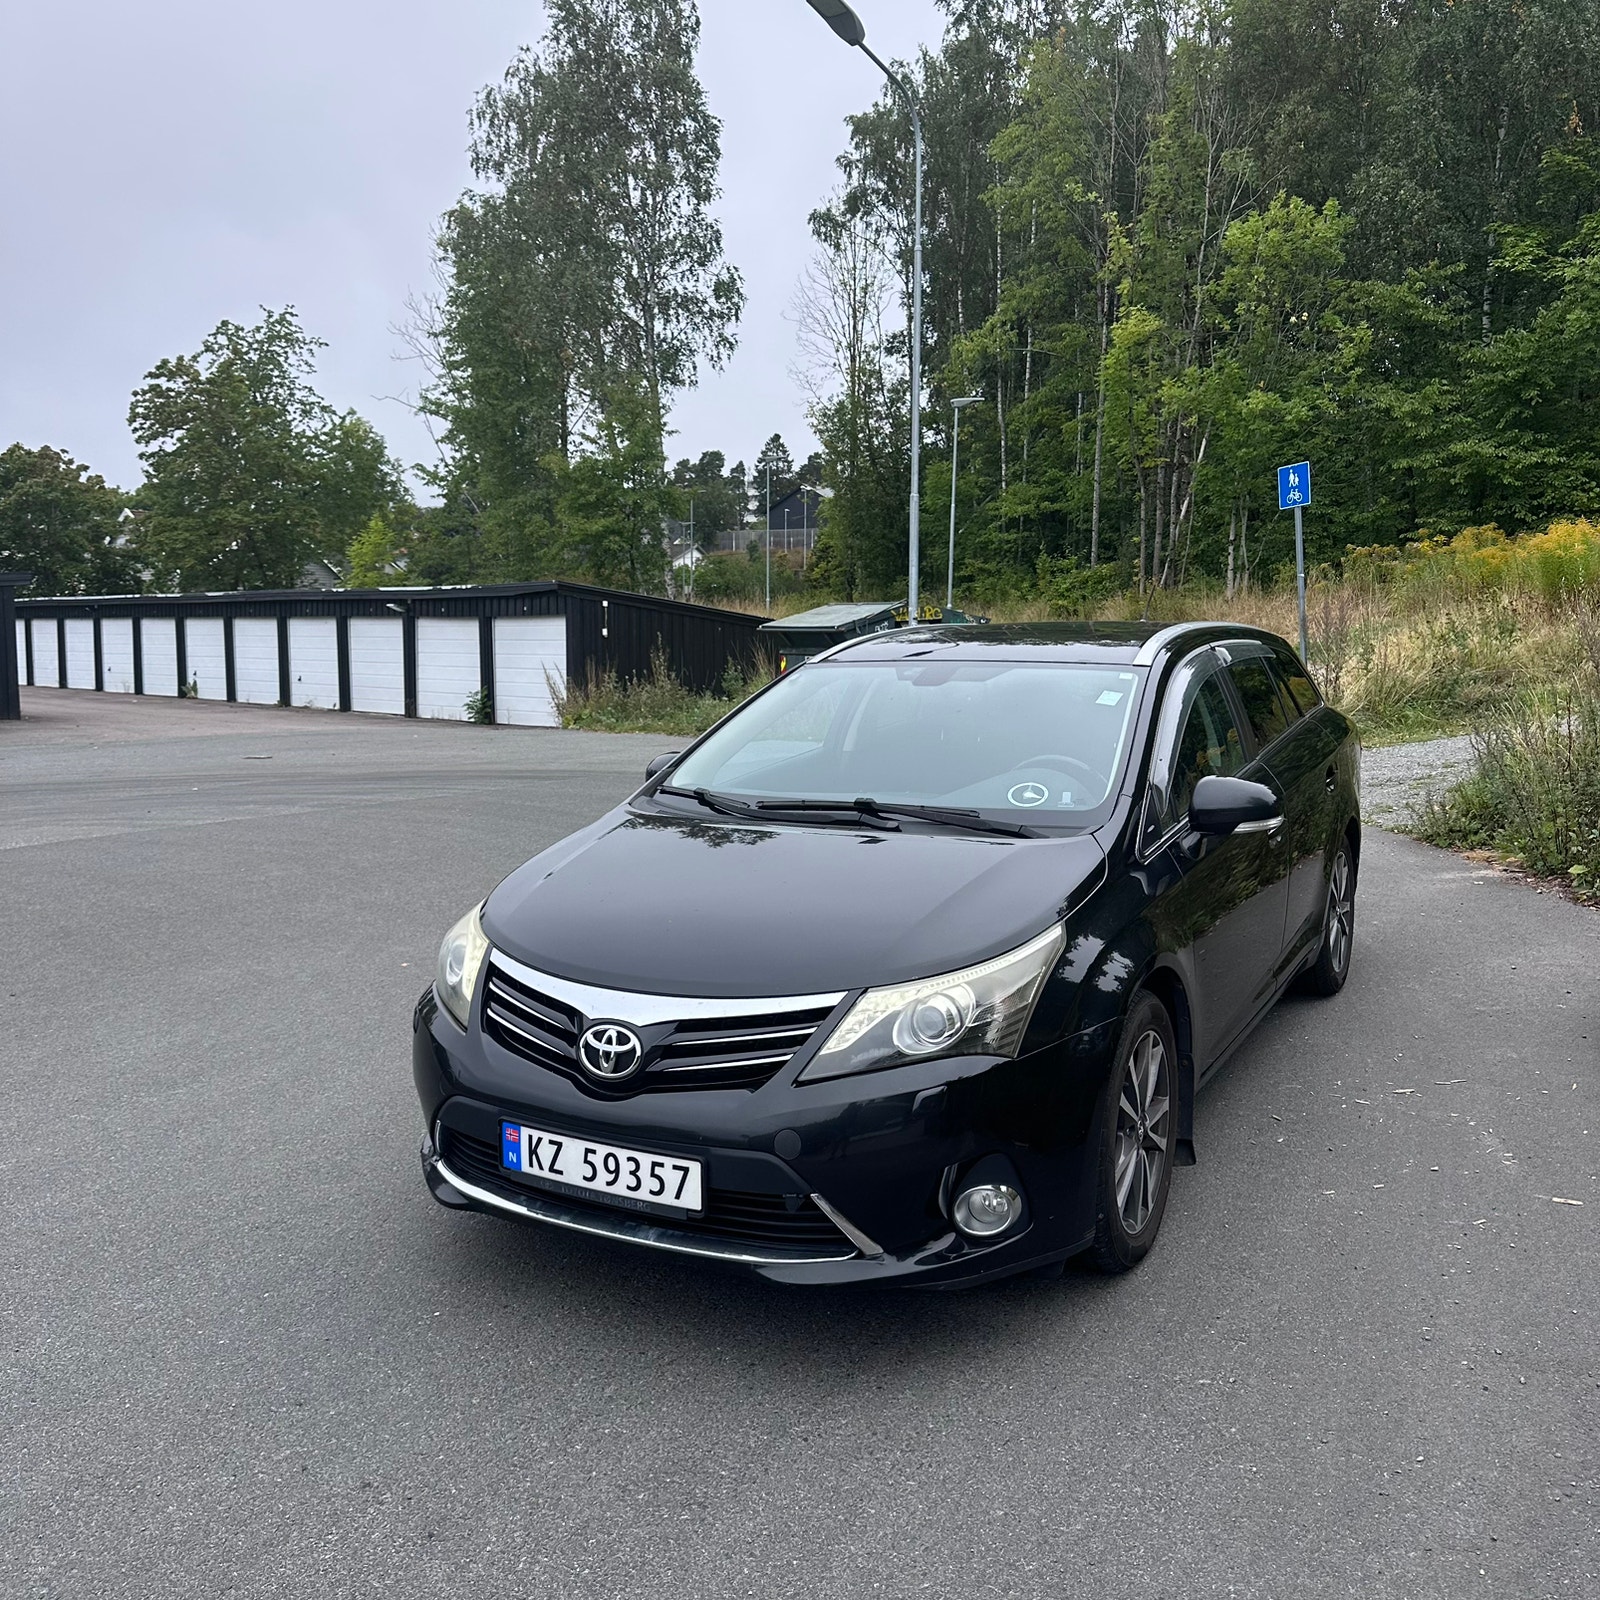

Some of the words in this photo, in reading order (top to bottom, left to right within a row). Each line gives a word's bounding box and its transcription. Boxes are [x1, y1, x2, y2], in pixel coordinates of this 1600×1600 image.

[508, 1151, 517, 1164] N
[527, 1133, 564, 1176] KZ
[582, 1147, 690, 1201] 59357
